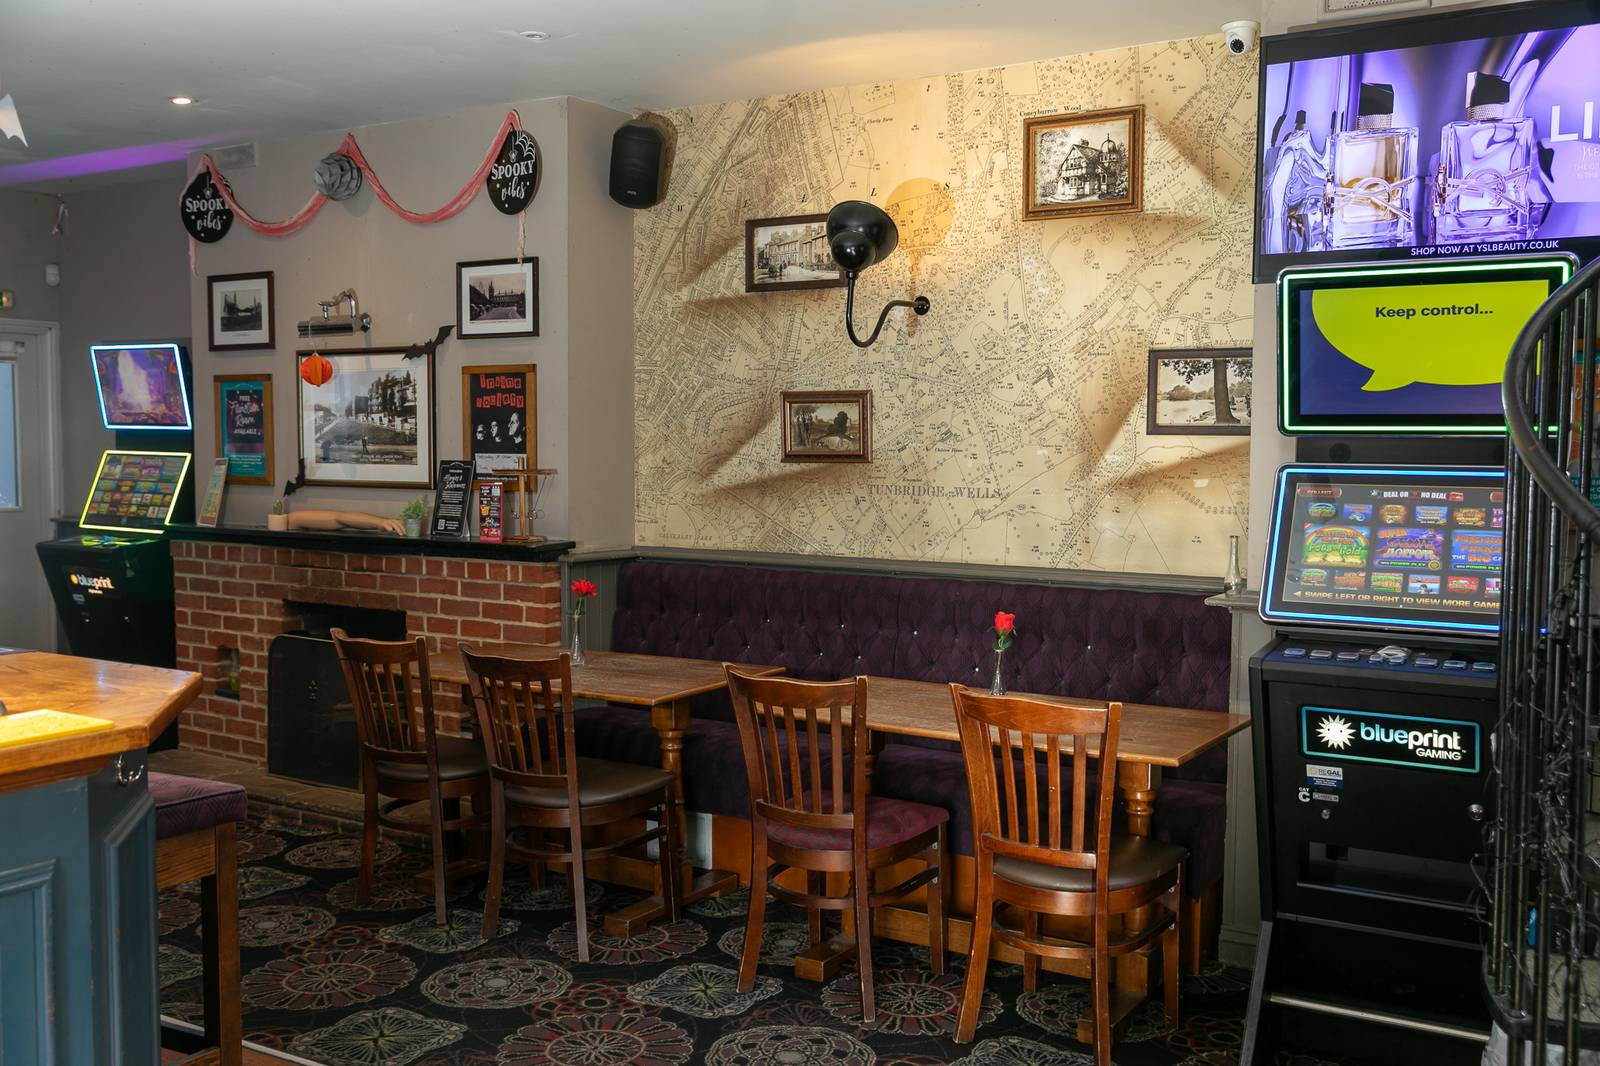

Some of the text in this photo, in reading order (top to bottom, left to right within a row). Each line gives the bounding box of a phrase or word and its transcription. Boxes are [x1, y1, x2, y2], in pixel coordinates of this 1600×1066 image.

[1551, 101, 1600, 142] LI
[491, 160, 535, 180] SPOOKY
[501, 176, 527, 200] vibes
[197, 210, 223, 230] vibes
[1410, 240, 1559, 256] SHOP NOW AT YSLBEAUTY.CO.UK
[1375, 303, 1494, 320] Keep control...
[953, 487, 1002, 500] WELLS
[1421, 491, 1430, 499] NO
[76, 574, 115, 590] blueprint
[1304, 591, 1334, 599] SWIPE
[1373, 595, 1400, 603] RIGHT
[1402, 596, 1414, 604] TO
[1416, 597, 1440, 605] VIEW
[1473, 601, 1501, 609] GAME
[1360, 722, 1462, 750] blueprint
[1415, 748, 1462, 761] GAMING
[1318, 768, 1342, 777] REGAL
[1298, 791, 1311, 803] C
